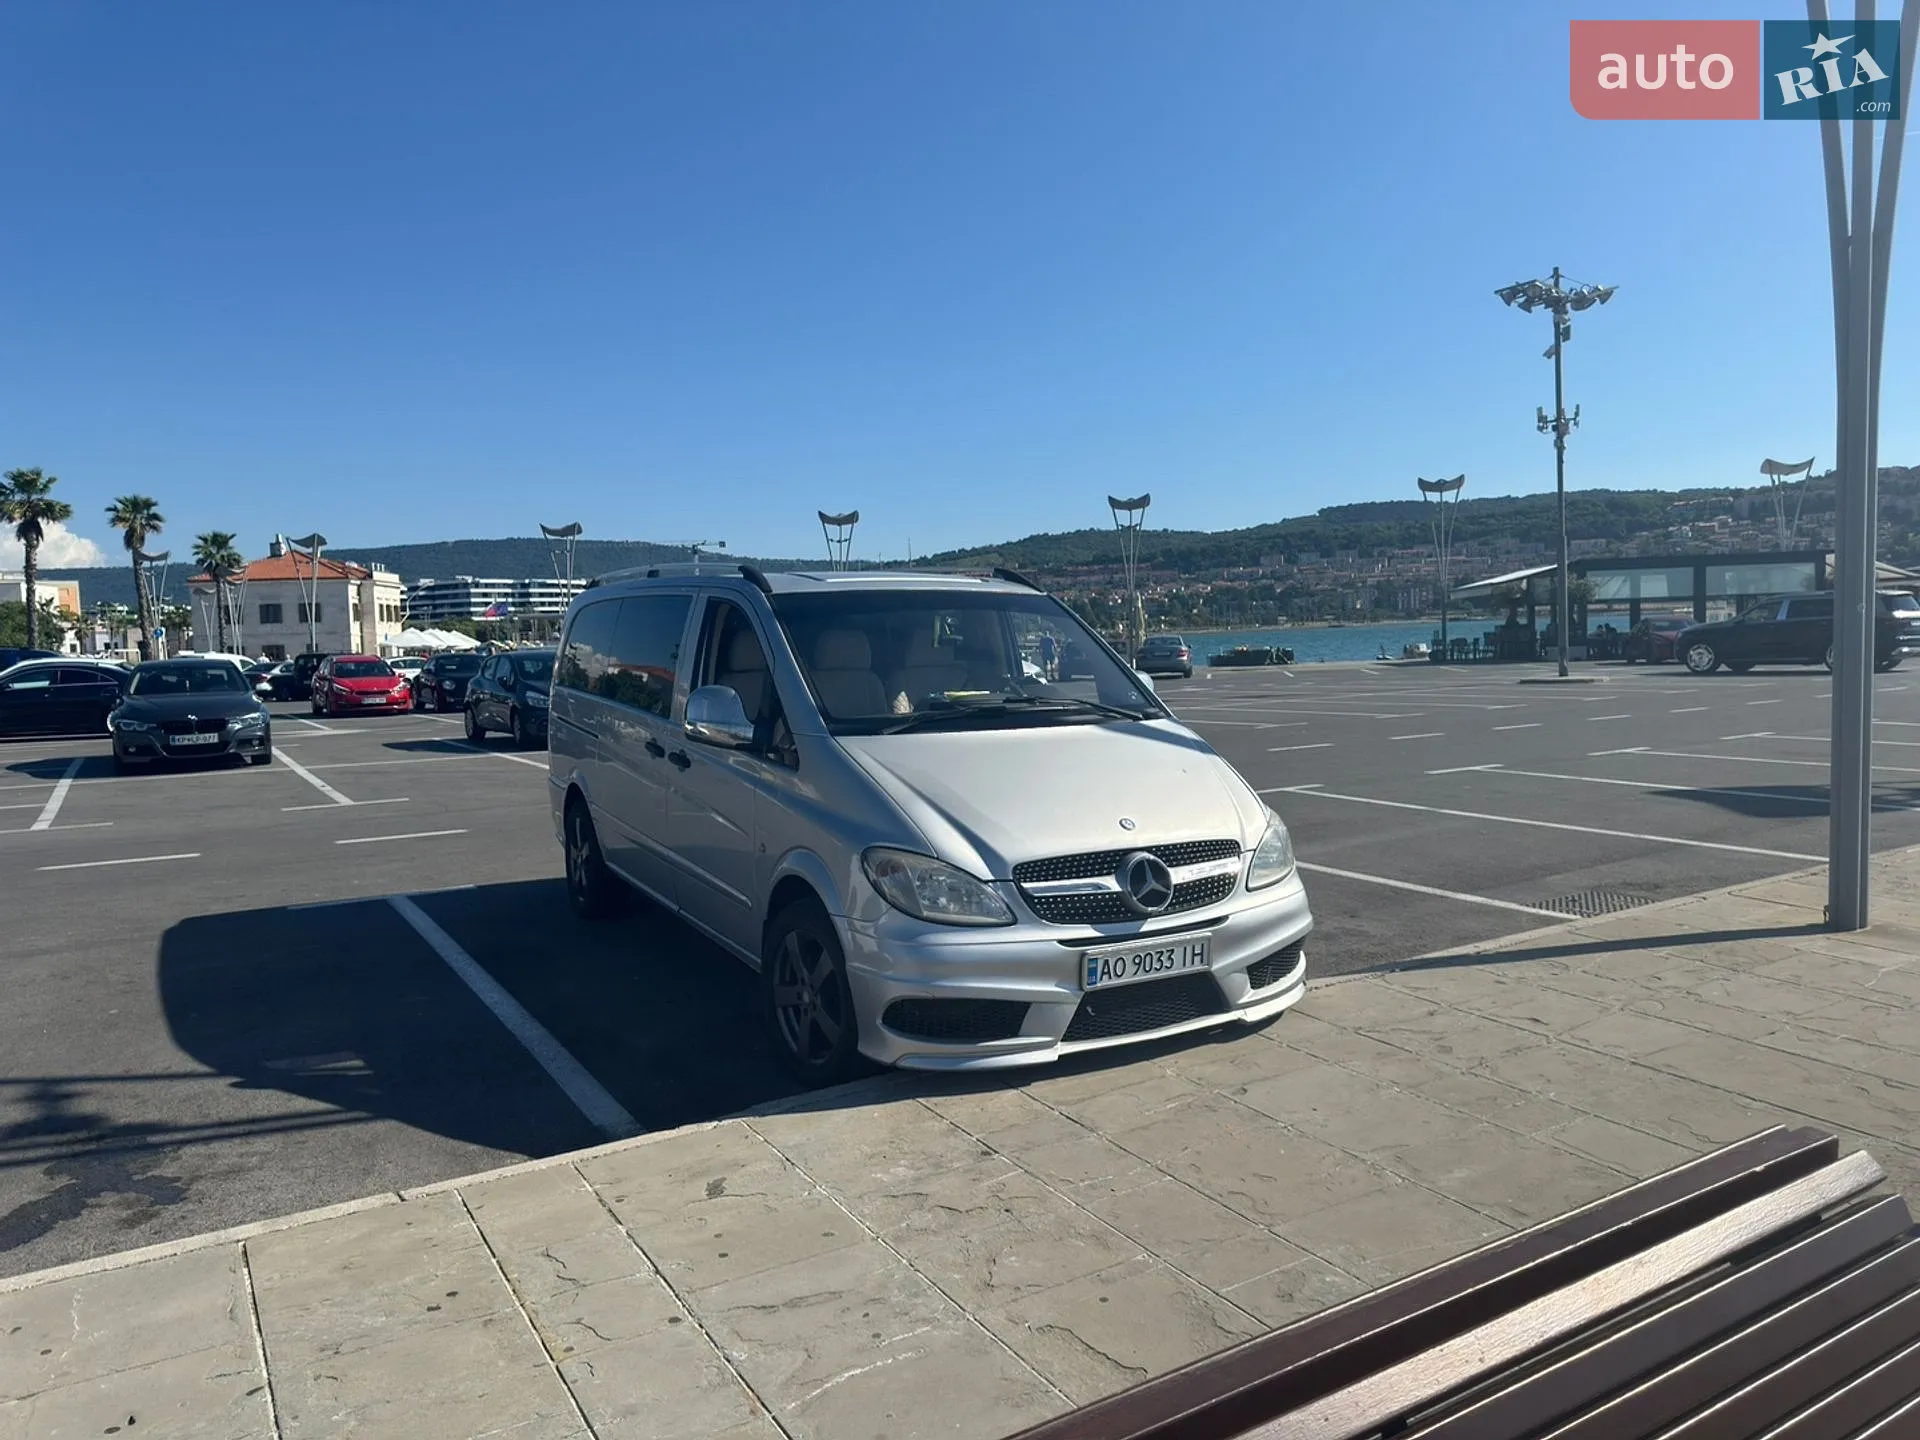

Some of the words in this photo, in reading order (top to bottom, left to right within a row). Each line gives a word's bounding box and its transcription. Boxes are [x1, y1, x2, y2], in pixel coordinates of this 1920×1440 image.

[1100, 957, 1127, 981] AO
[1132, 948, 1175, 976] 9033
[1182, 943, 1205, 967] IH
